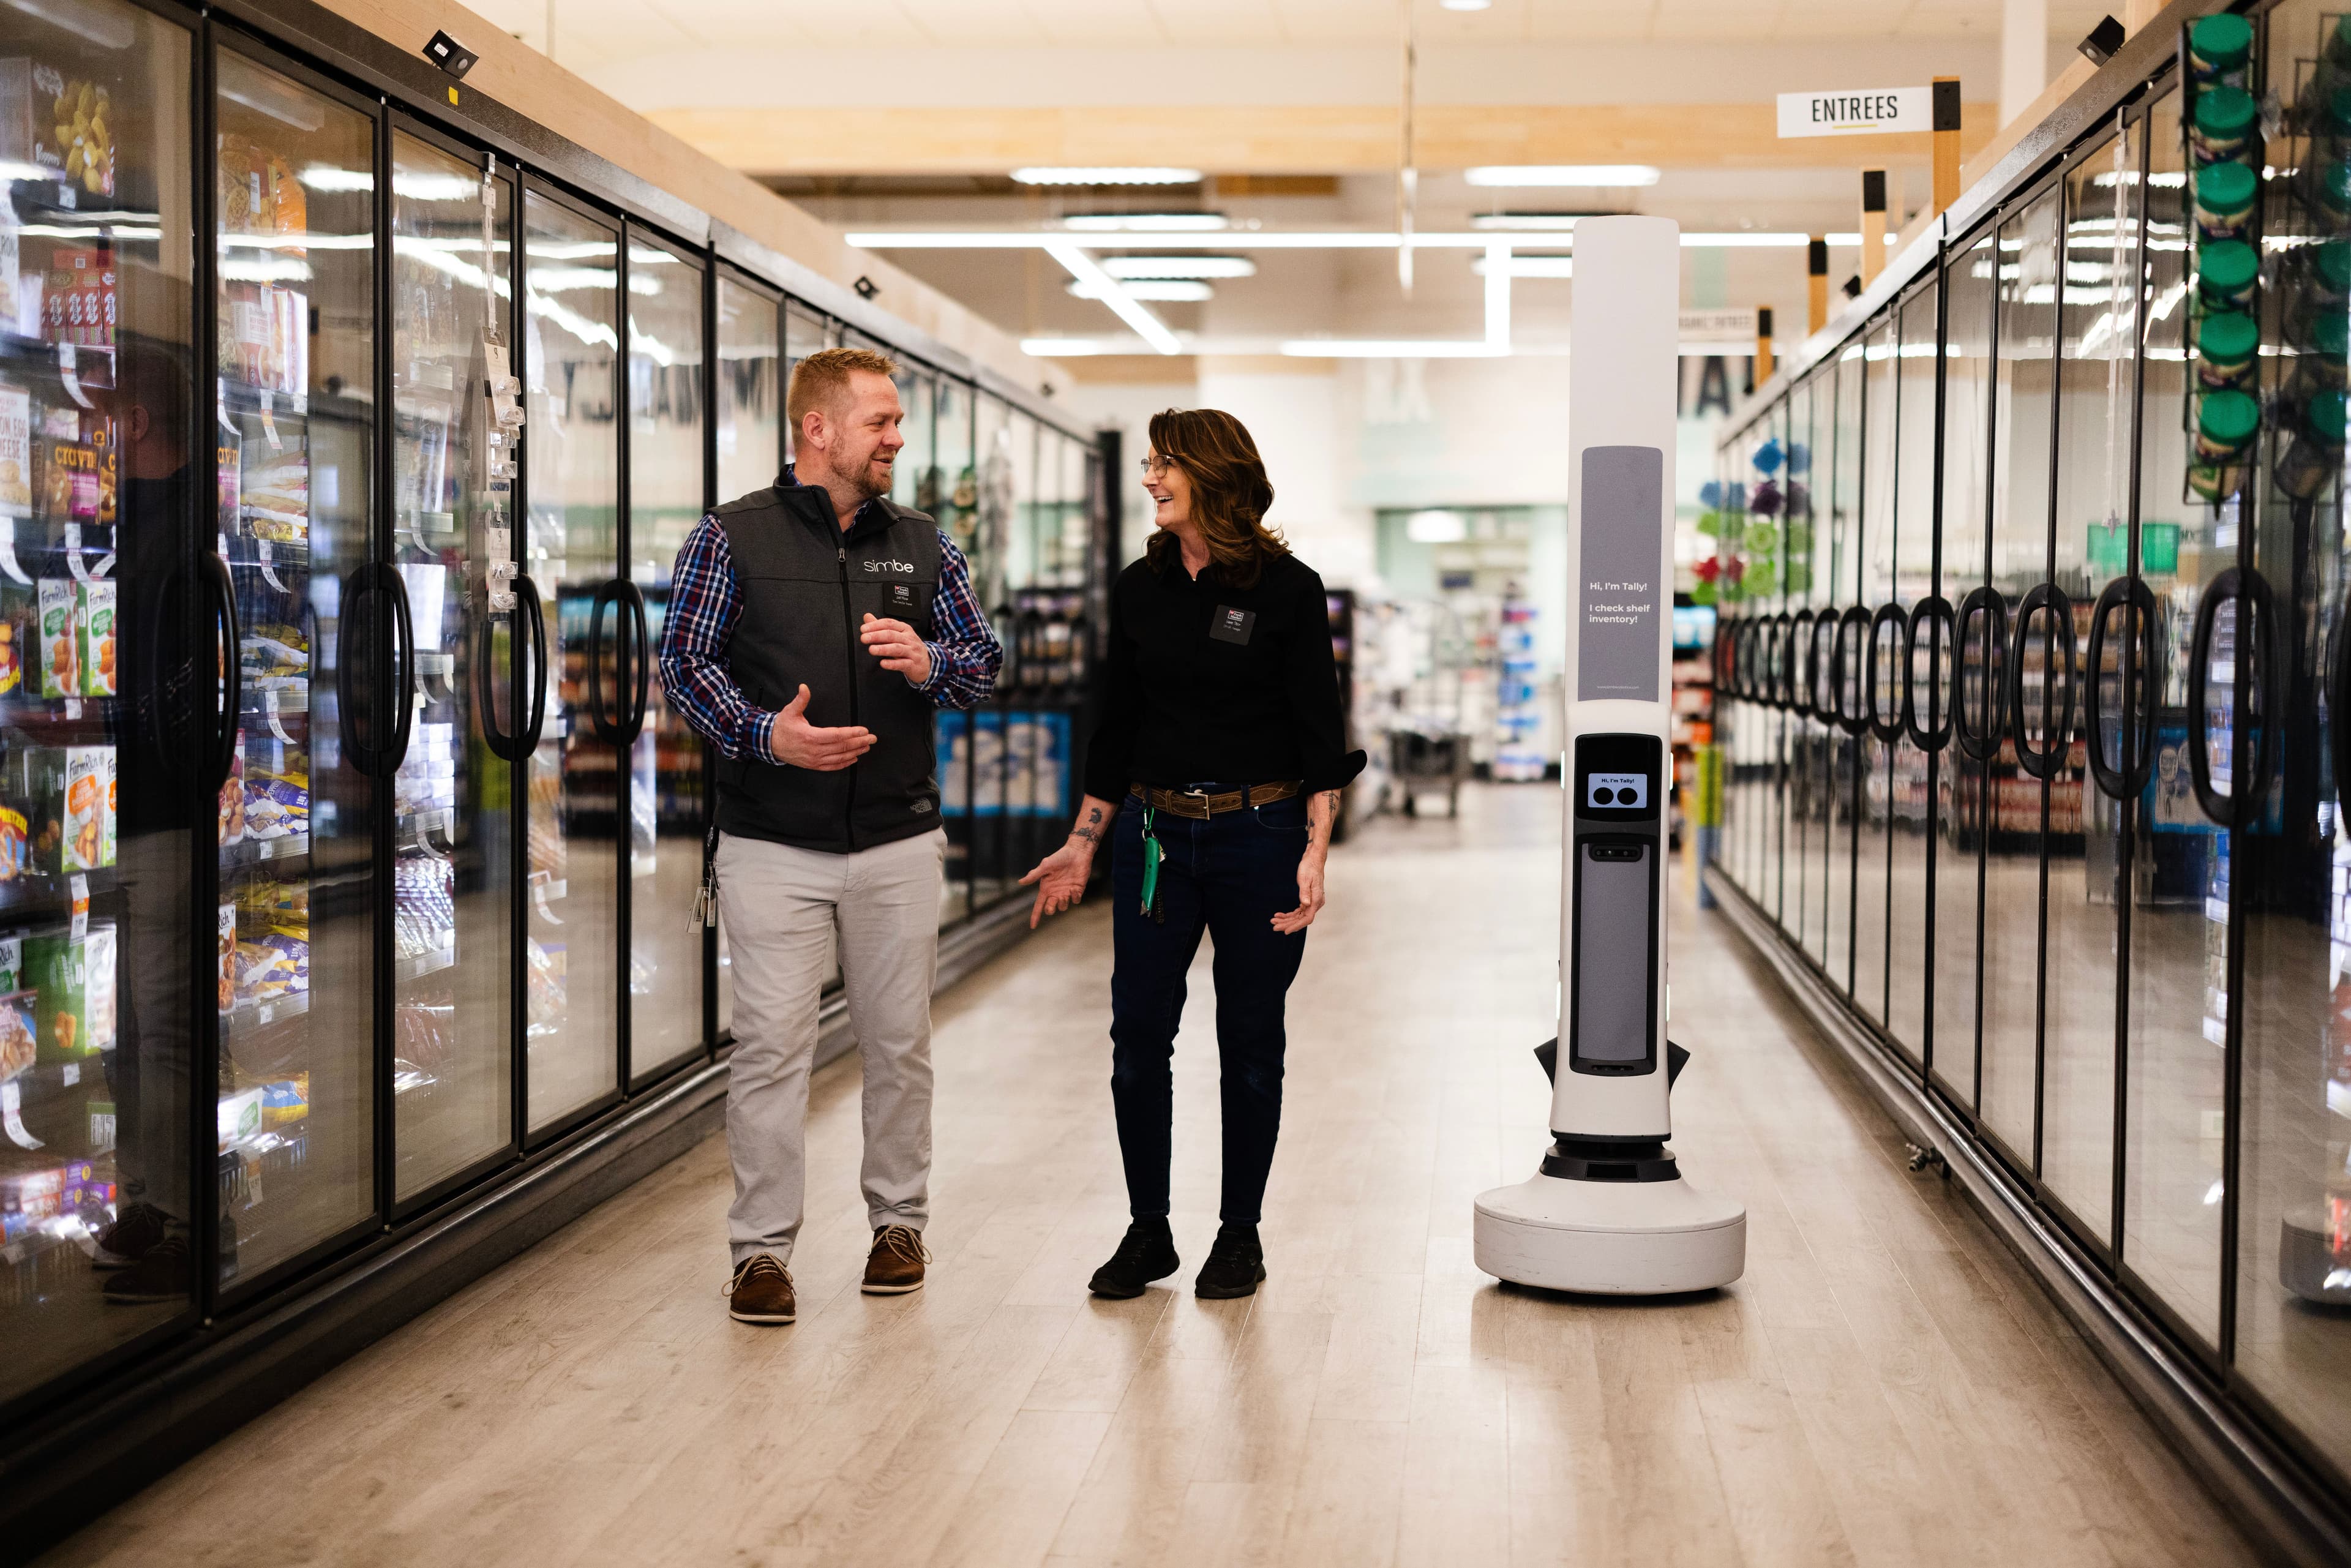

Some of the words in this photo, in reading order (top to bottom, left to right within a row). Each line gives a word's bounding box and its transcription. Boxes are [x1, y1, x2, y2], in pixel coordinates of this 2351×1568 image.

[1812, 96, 1898, 122] ENTREES
[864, 559, 914, 573] simbe
[1590, 582, 1602, 591] Hi,
[1605, 582, 1620, 591] I'm
[1622, 582, 1648, 592] Tally!
[1595, 604, 1624, 612] check
[1626, 604, 1651, 612] shelf
[1589, 615, 1638, 625] inventory!
